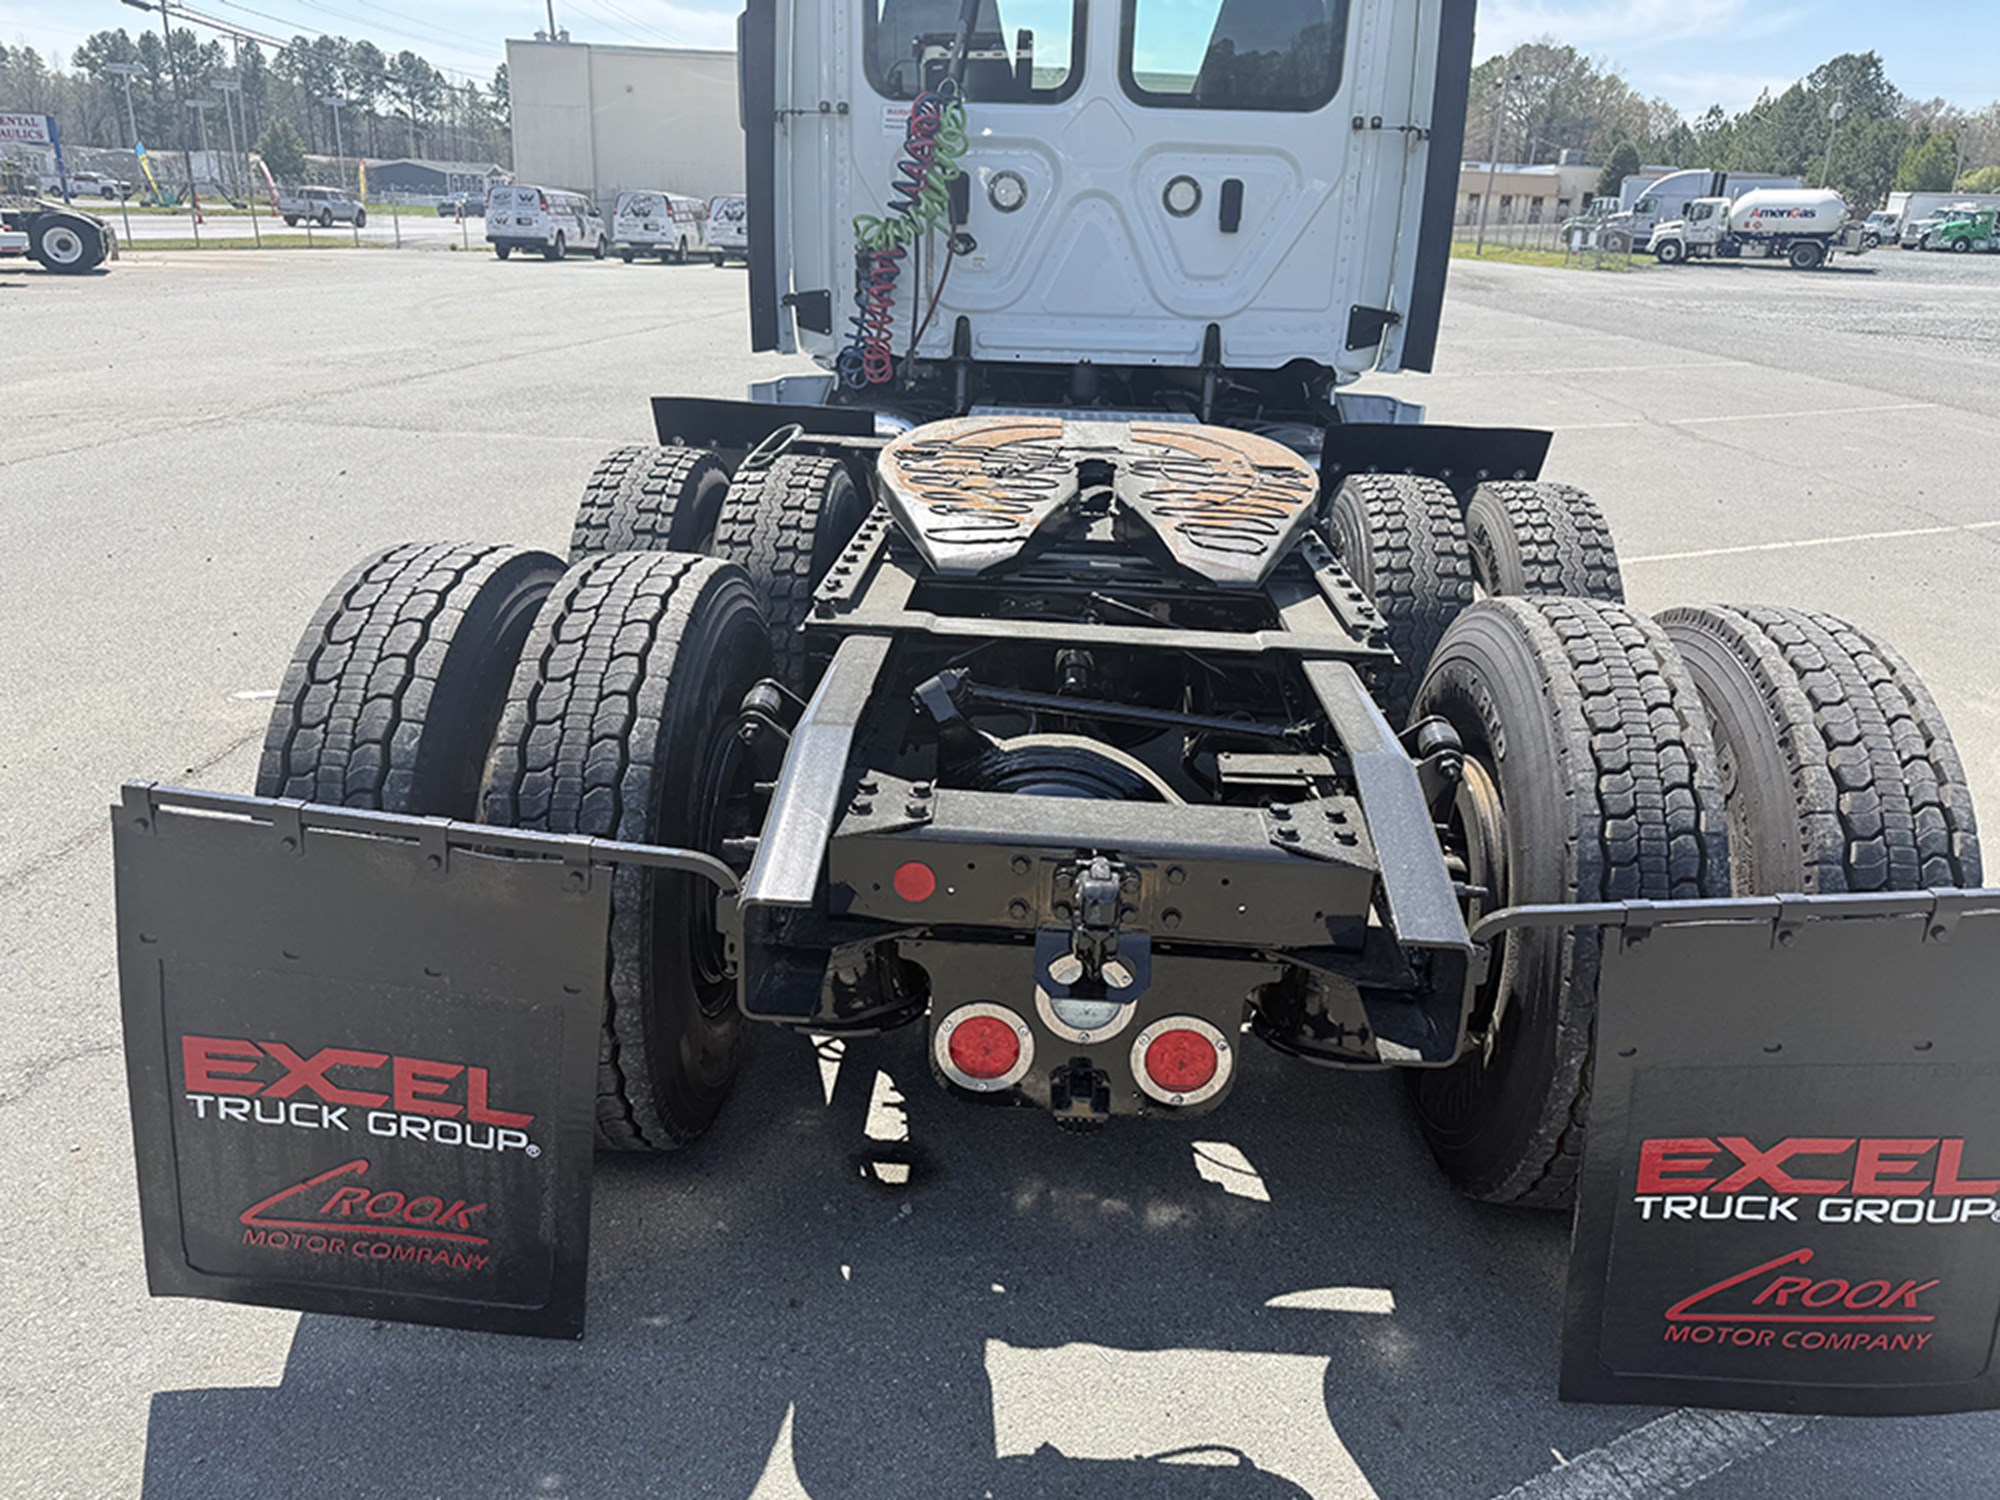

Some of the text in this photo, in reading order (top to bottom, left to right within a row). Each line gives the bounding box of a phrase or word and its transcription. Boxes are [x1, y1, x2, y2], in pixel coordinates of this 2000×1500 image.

[1749, 207, 1817, 218] AmeriGas
[181, 1035, 535, 1128] EXCEL
[185, 1093, 350, 1132] TRUCK
[1636, 1137, 2000, 1196] EXCEL
[1634, 1195, 1799, 1222] TRUCK
[241, 1228, 491, 1270] MOTOR COMPANY
[1663, 1324, 1933, 1352] MOTOR COMPANY
